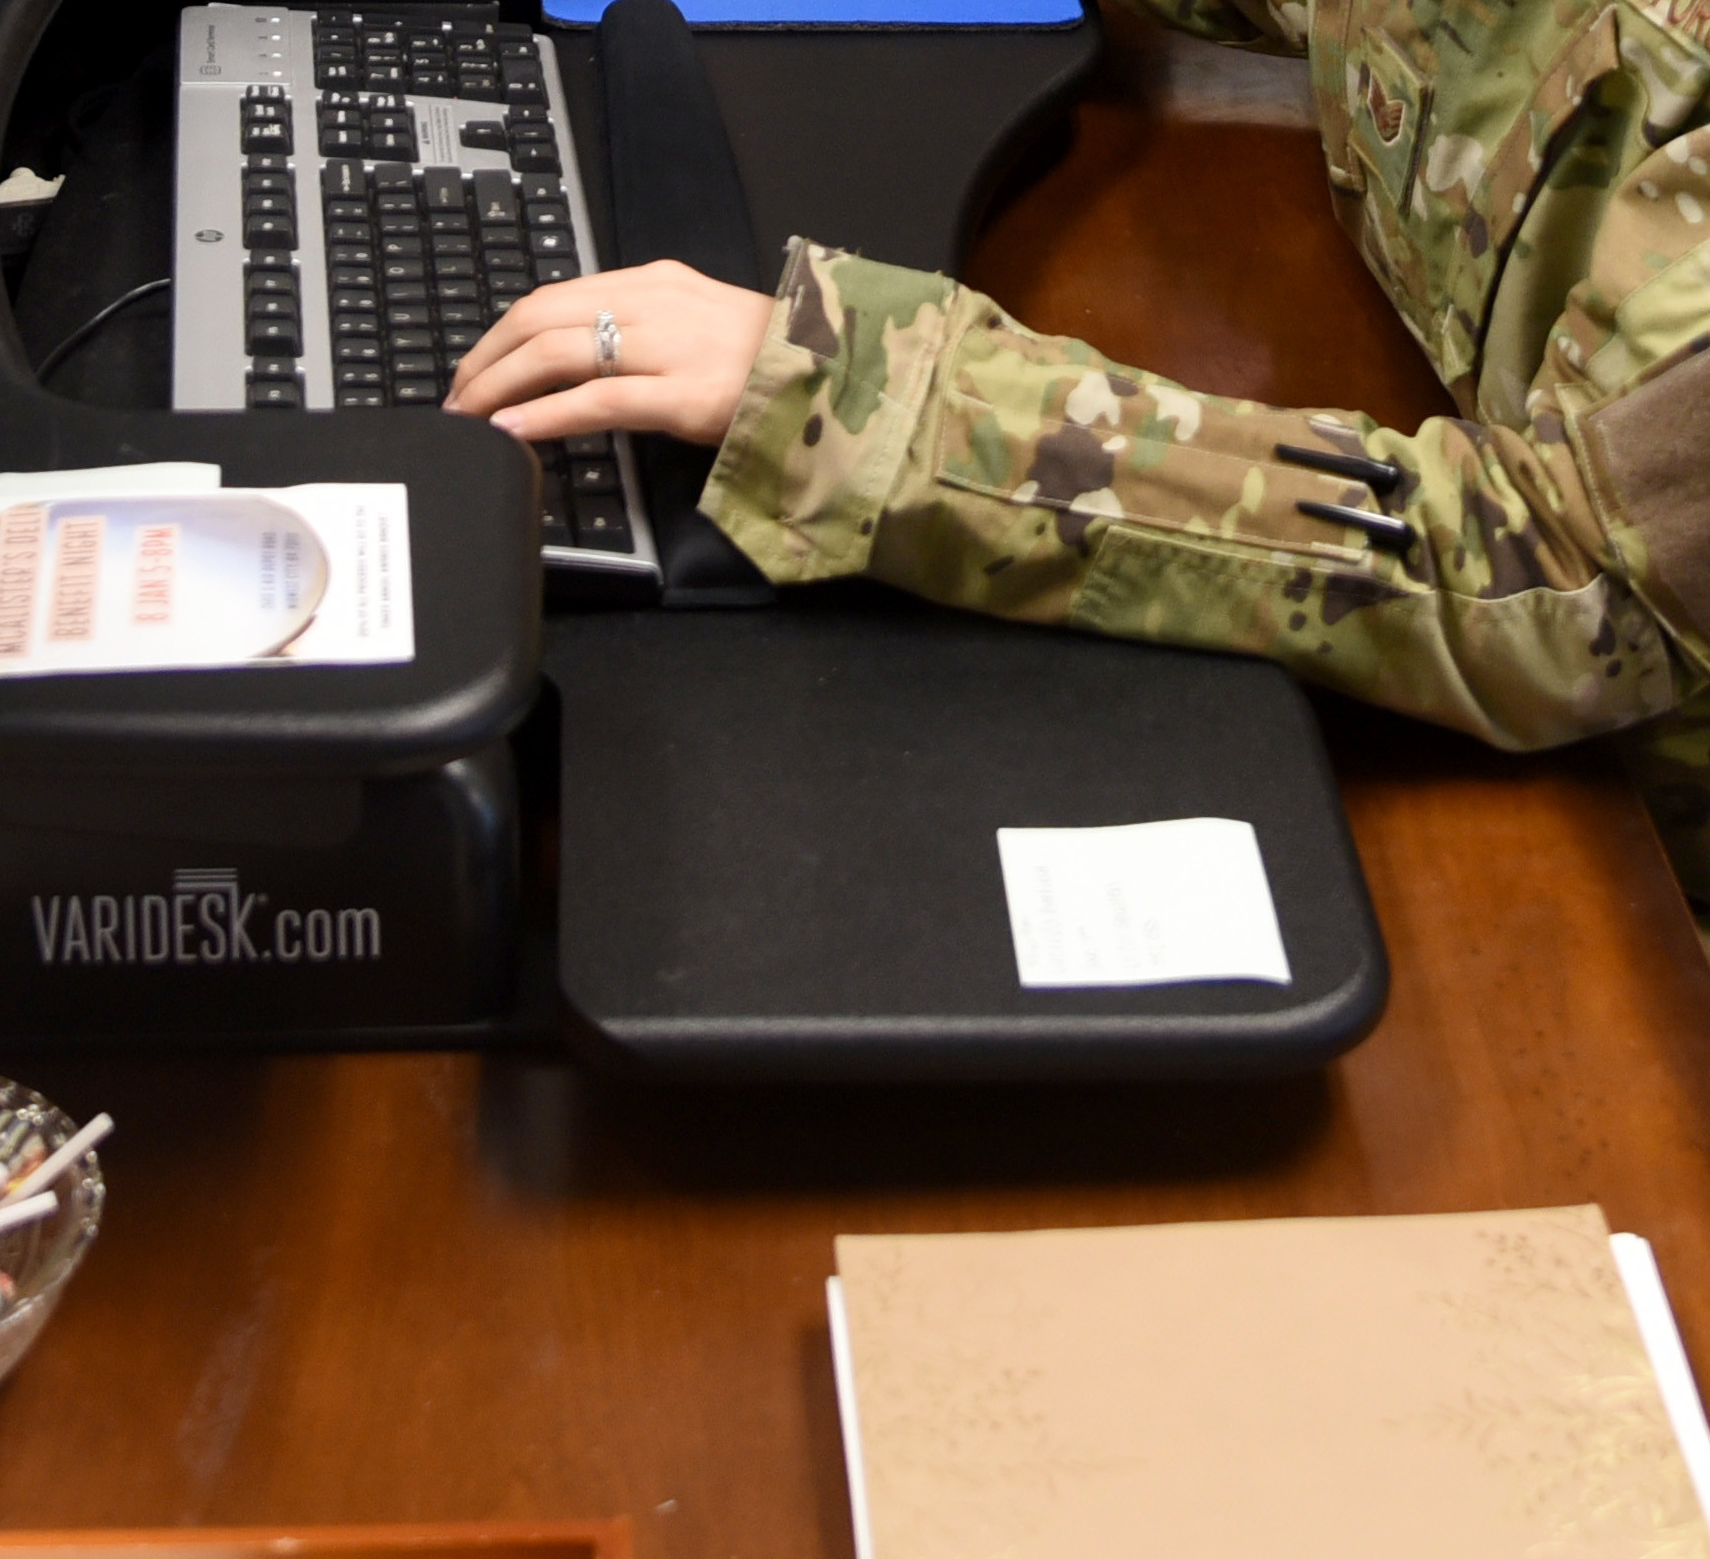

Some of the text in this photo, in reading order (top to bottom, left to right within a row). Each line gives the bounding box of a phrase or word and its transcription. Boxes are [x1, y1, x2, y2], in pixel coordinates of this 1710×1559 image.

[54, 520, 99, 638] BENEFIT NIGHT
[141, 526, 173, 573] 5-8PM
[138, 580, 169, 604] JAN
[32, 882, 381, 964] VARIDESK.com
